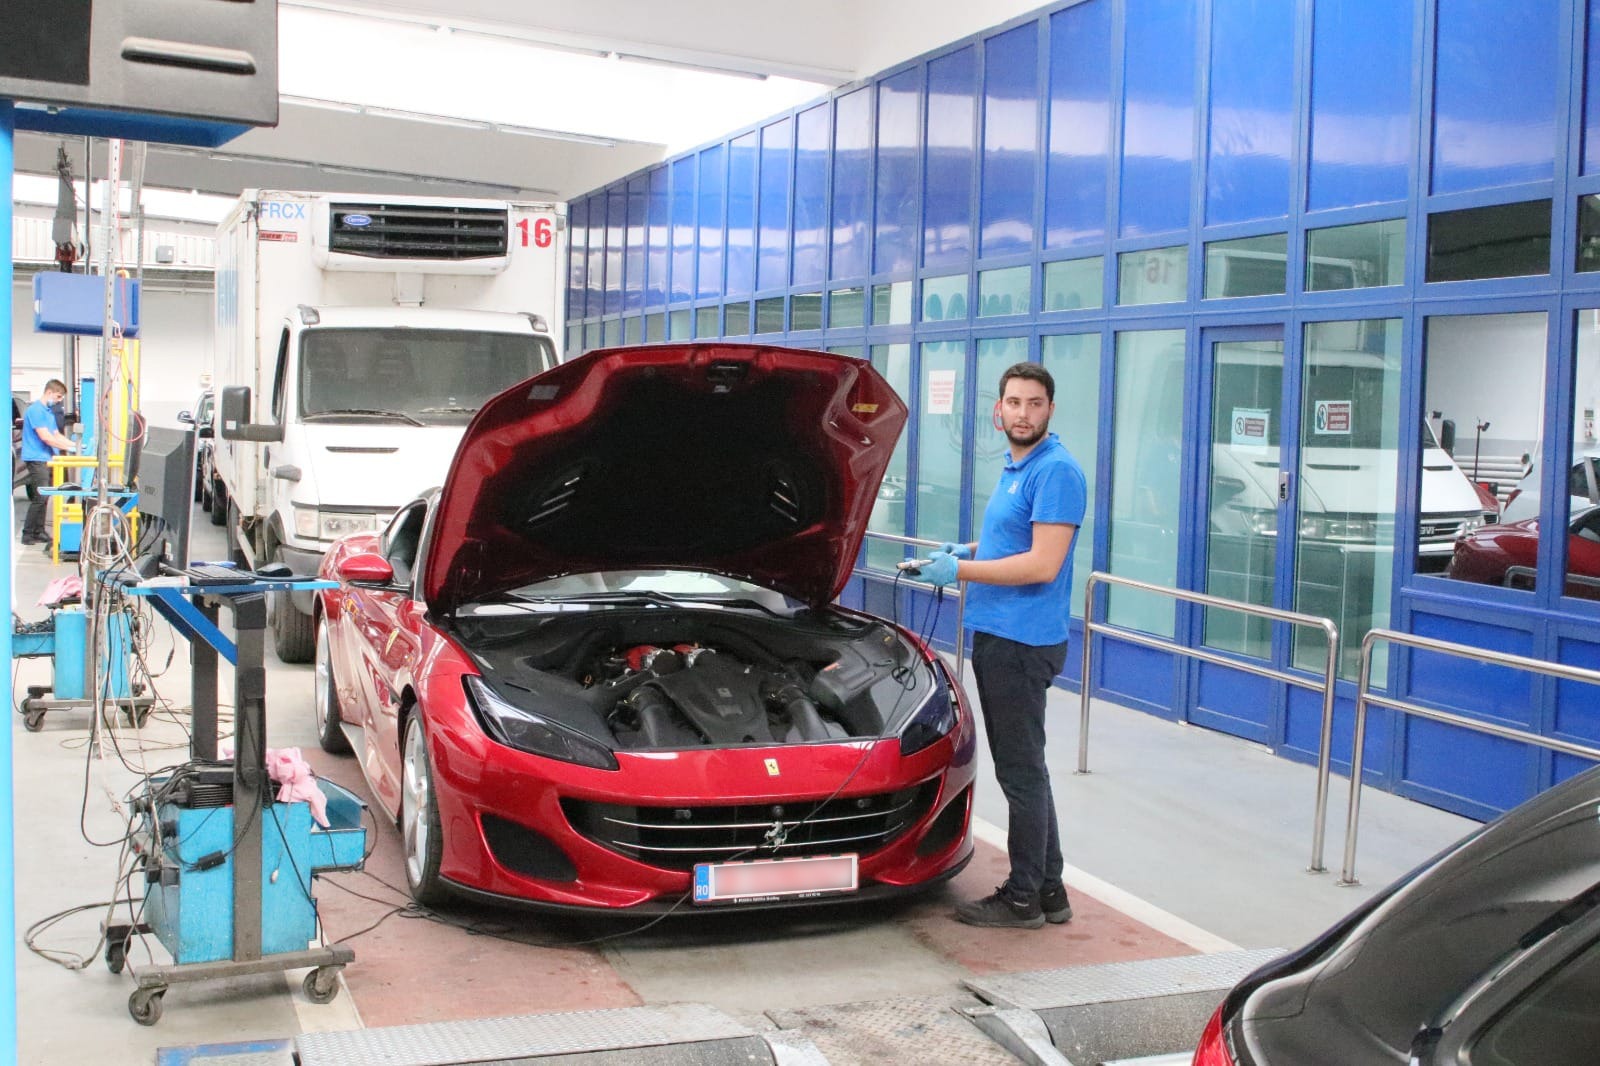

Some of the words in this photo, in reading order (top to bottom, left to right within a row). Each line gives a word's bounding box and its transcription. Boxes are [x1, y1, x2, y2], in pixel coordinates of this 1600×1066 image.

[260, 202, 305, 219] FRCX
[516, 218, 552, 248] 16
[696, 885, 708, 896] RO
